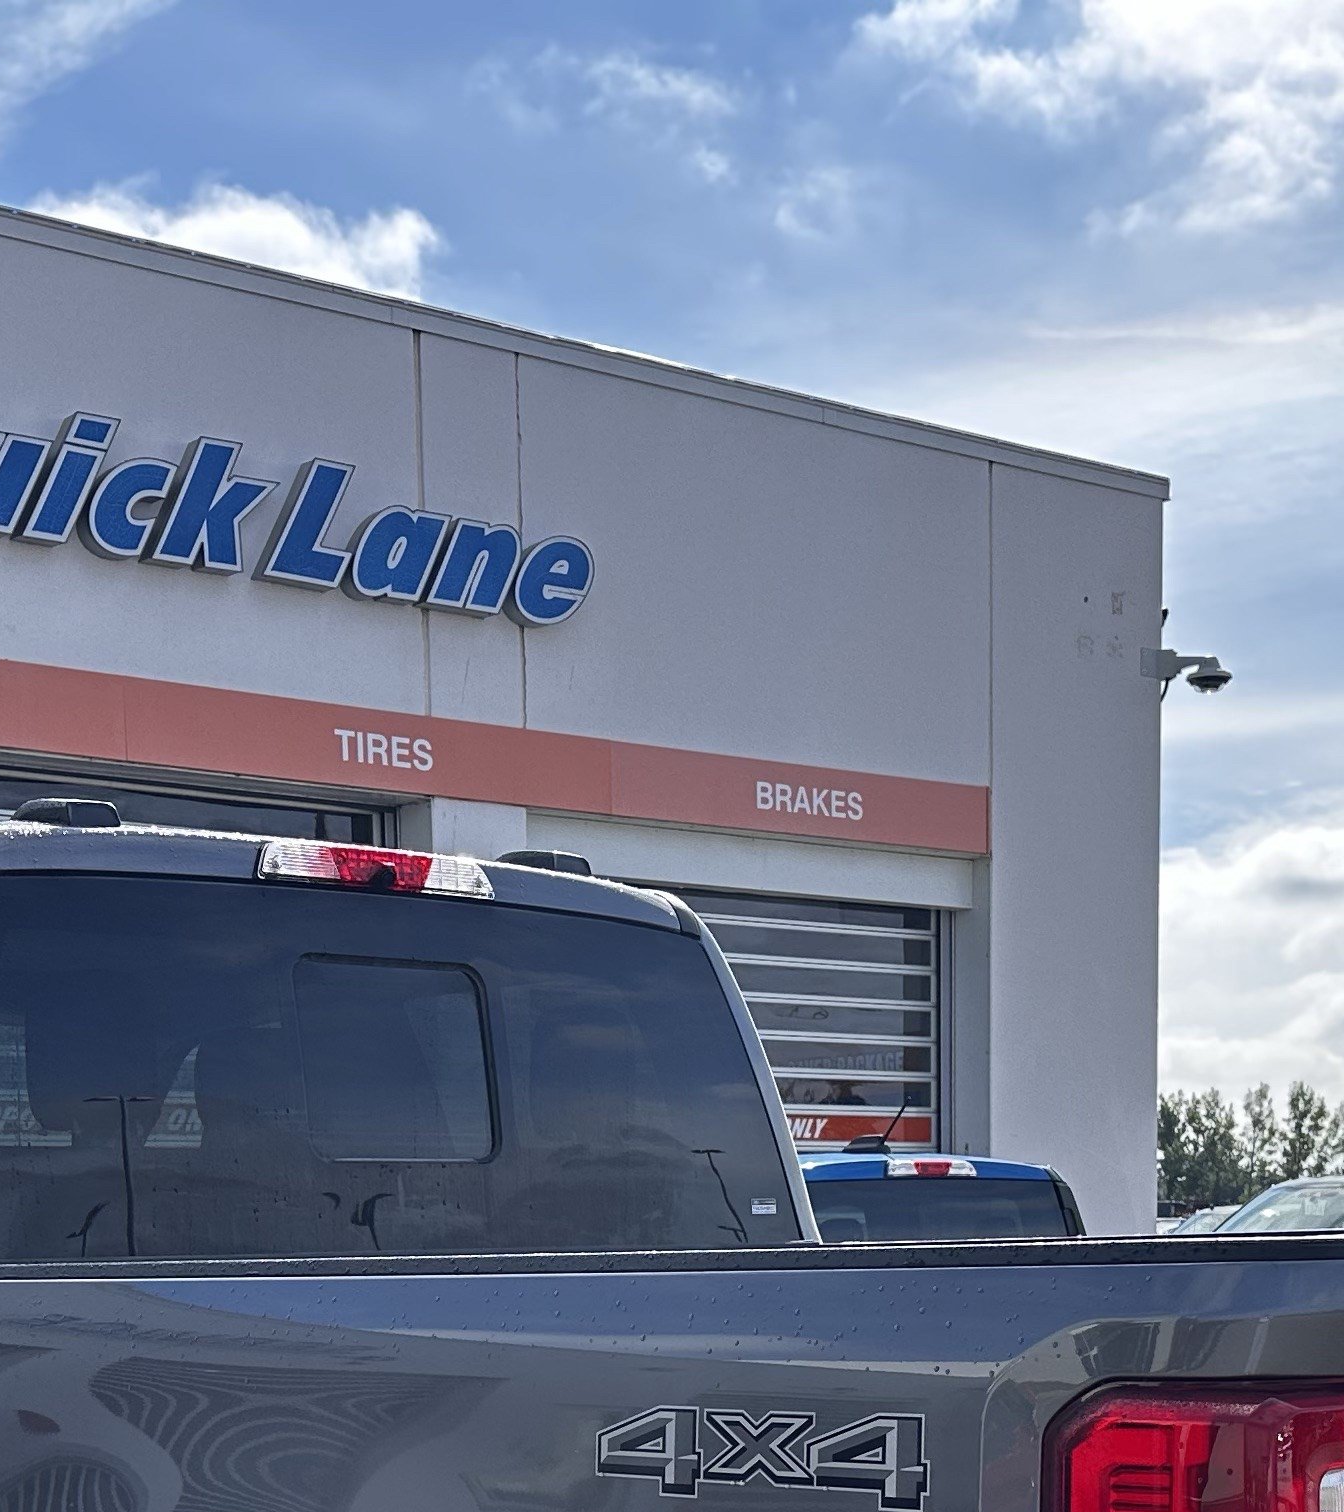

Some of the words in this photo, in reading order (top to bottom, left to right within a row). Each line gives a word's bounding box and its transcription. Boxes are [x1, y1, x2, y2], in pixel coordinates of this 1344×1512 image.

[256, 458, 594, 627] Lane
[334, 728, 434, 772] TIRES
[756, 781, 864, 820] BRAKES
